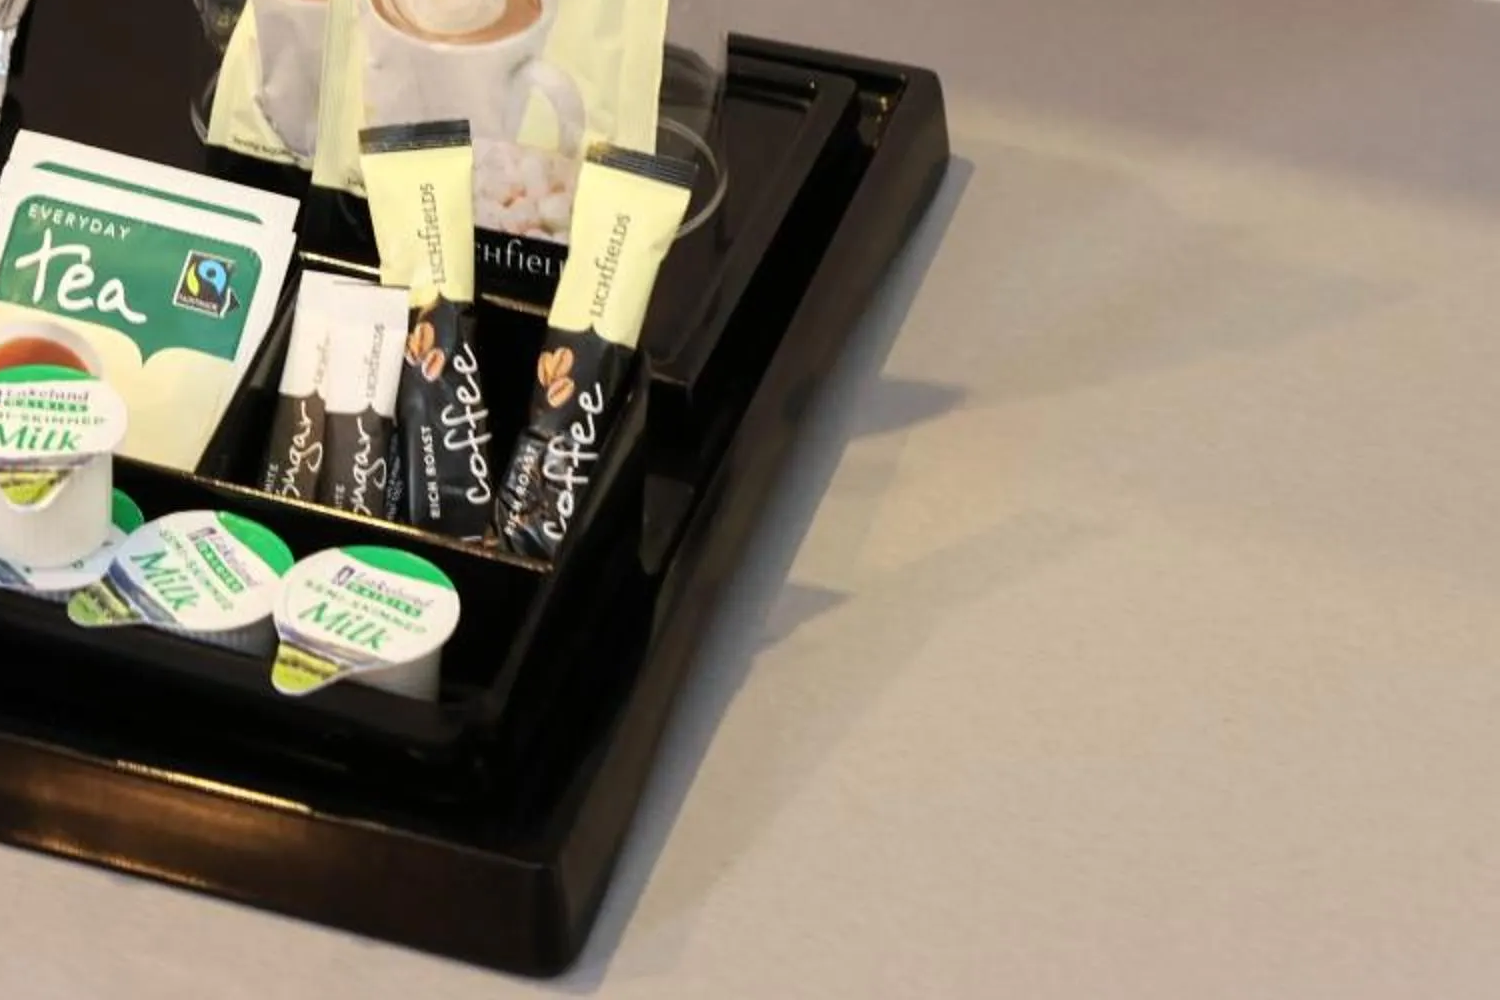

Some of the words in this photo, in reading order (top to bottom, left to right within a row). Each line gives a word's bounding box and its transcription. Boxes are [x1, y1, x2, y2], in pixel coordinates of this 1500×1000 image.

[27, 202, 133, 242] EVERYDAY
[14, 228, 148, 325] tea
[420, 426, 438, 476] ROAST
[440, 342, 493, 505] coffee
[542, 381, 604, 541] coffee
[426, 481, 441, 519] RICH
[129, 550, 200, 611] Milk
[297, 601, 392, 650] Milk
